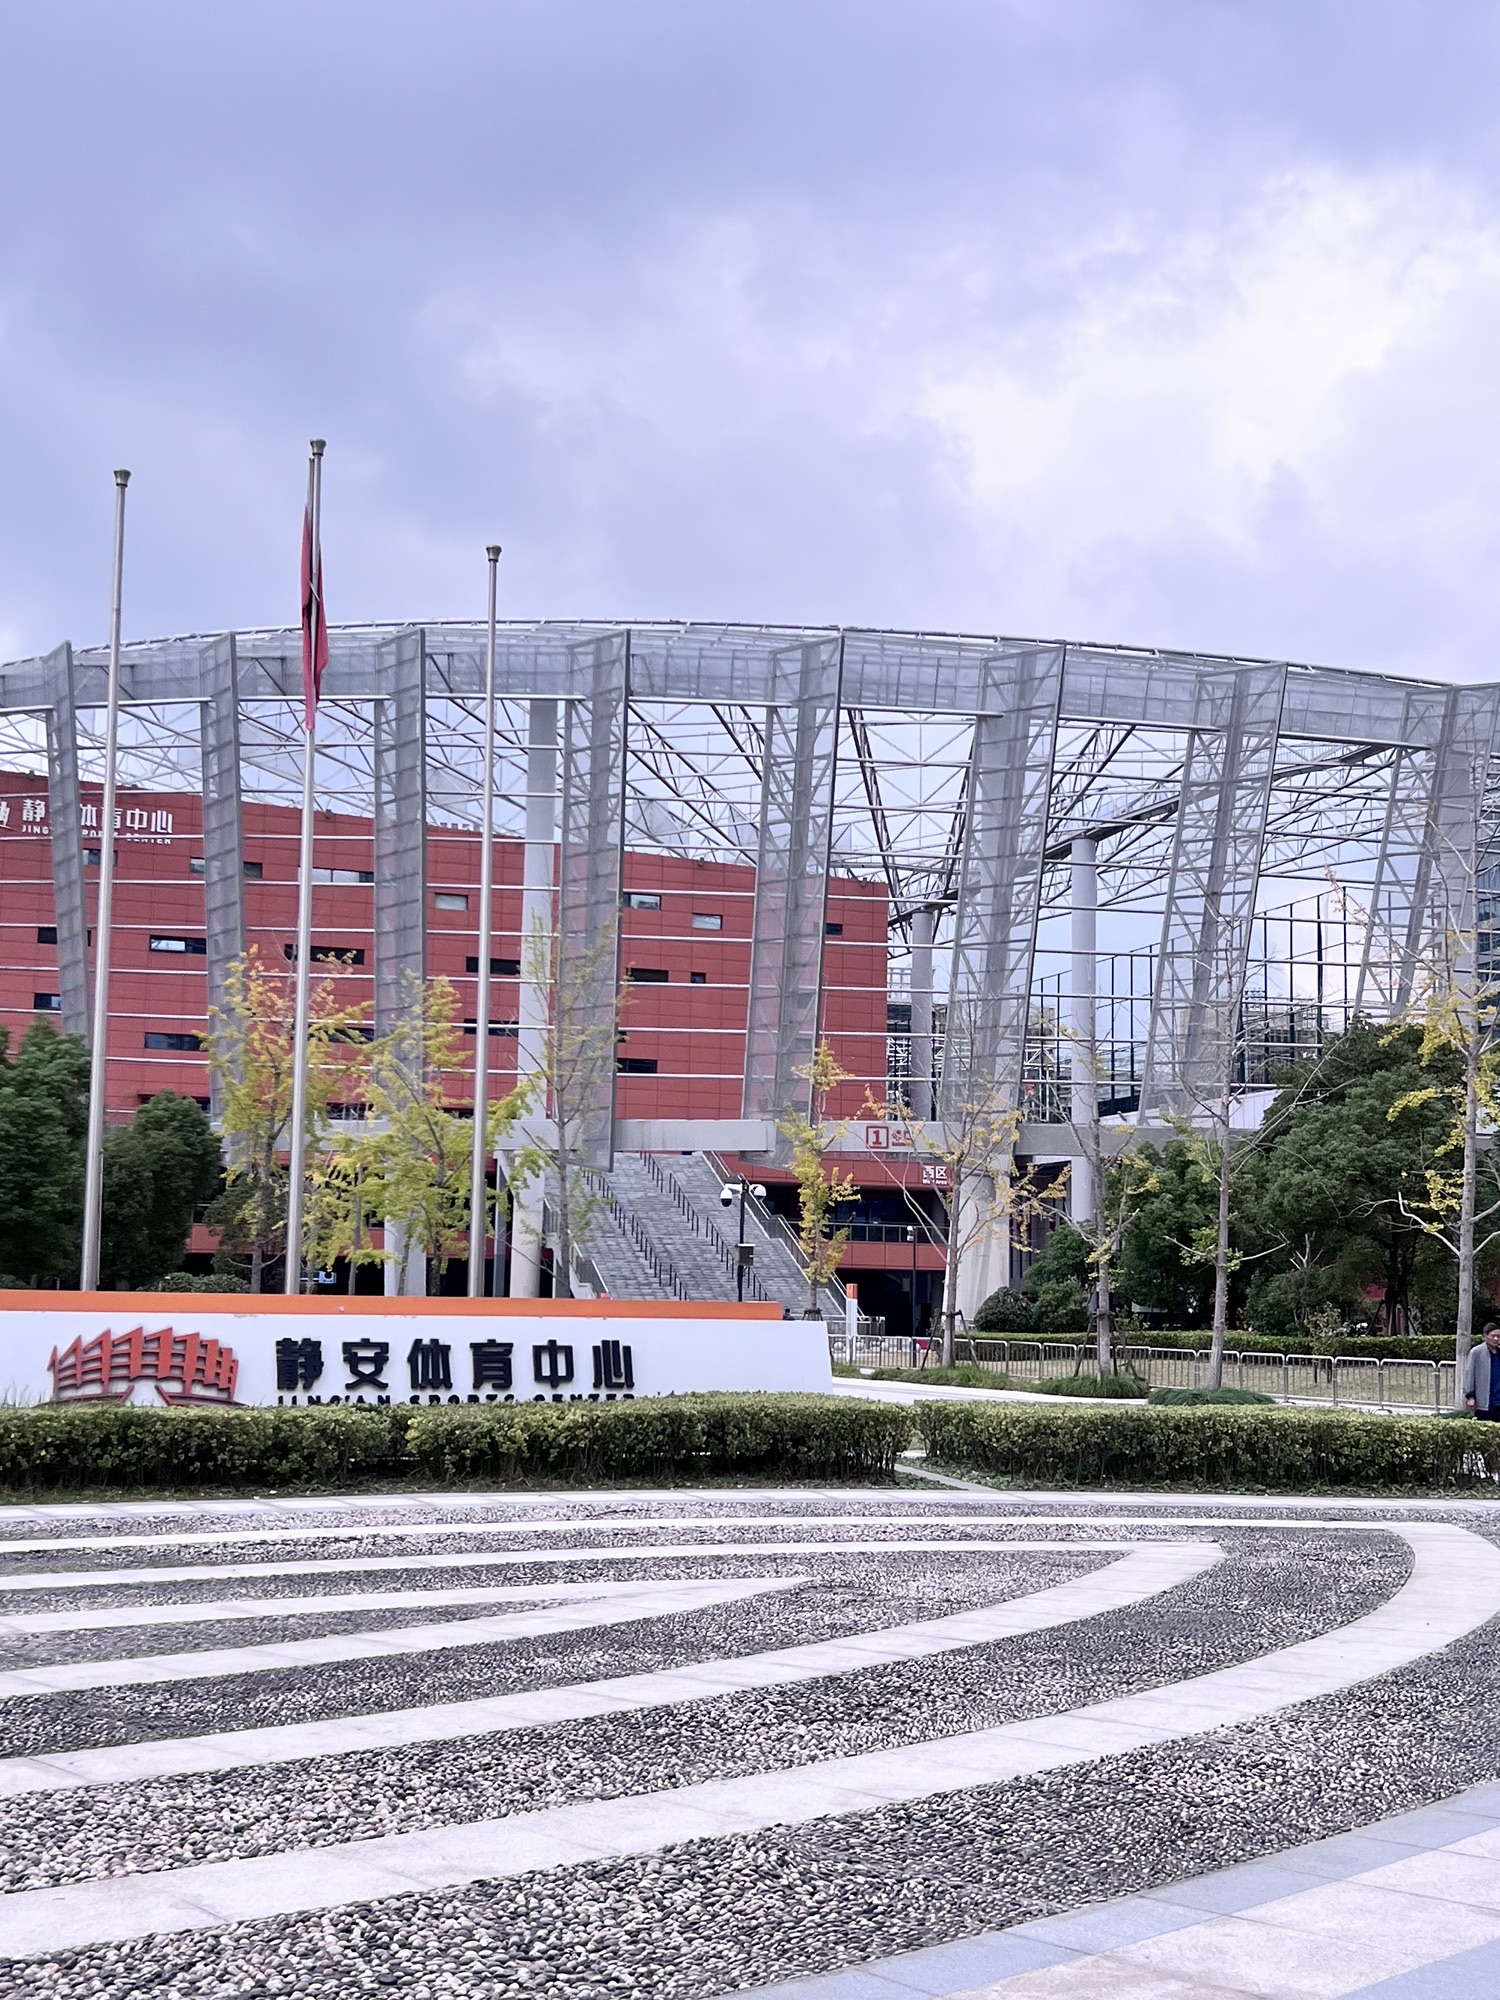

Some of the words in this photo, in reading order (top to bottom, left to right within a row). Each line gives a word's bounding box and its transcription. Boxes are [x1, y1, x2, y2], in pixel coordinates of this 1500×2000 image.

[872, 1130, 882, 1145] 1
[923, 1165, 947, 1179] 西区
[275, 1337, 635, 1389] 静安体育中心
